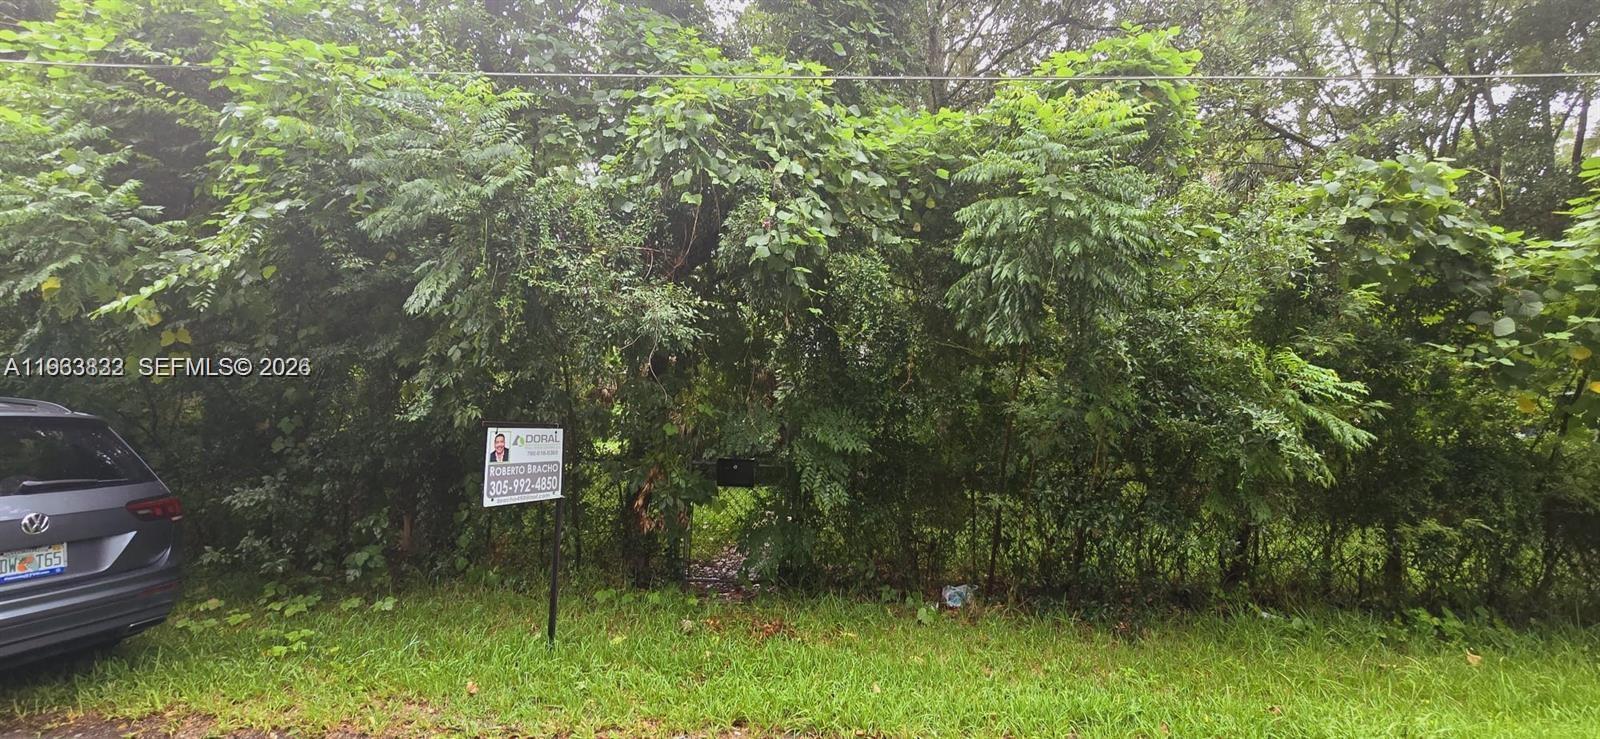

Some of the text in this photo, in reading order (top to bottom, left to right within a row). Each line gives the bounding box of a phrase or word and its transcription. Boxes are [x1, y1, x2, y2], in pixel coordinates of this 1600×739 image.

[525, 434, 560, 444] DORAL
[489, 463, 559, 477] ROBERTO BRACHO
[489, 476, 558, 497] 305-992-4850
[36, 550, 62, 569] T65
